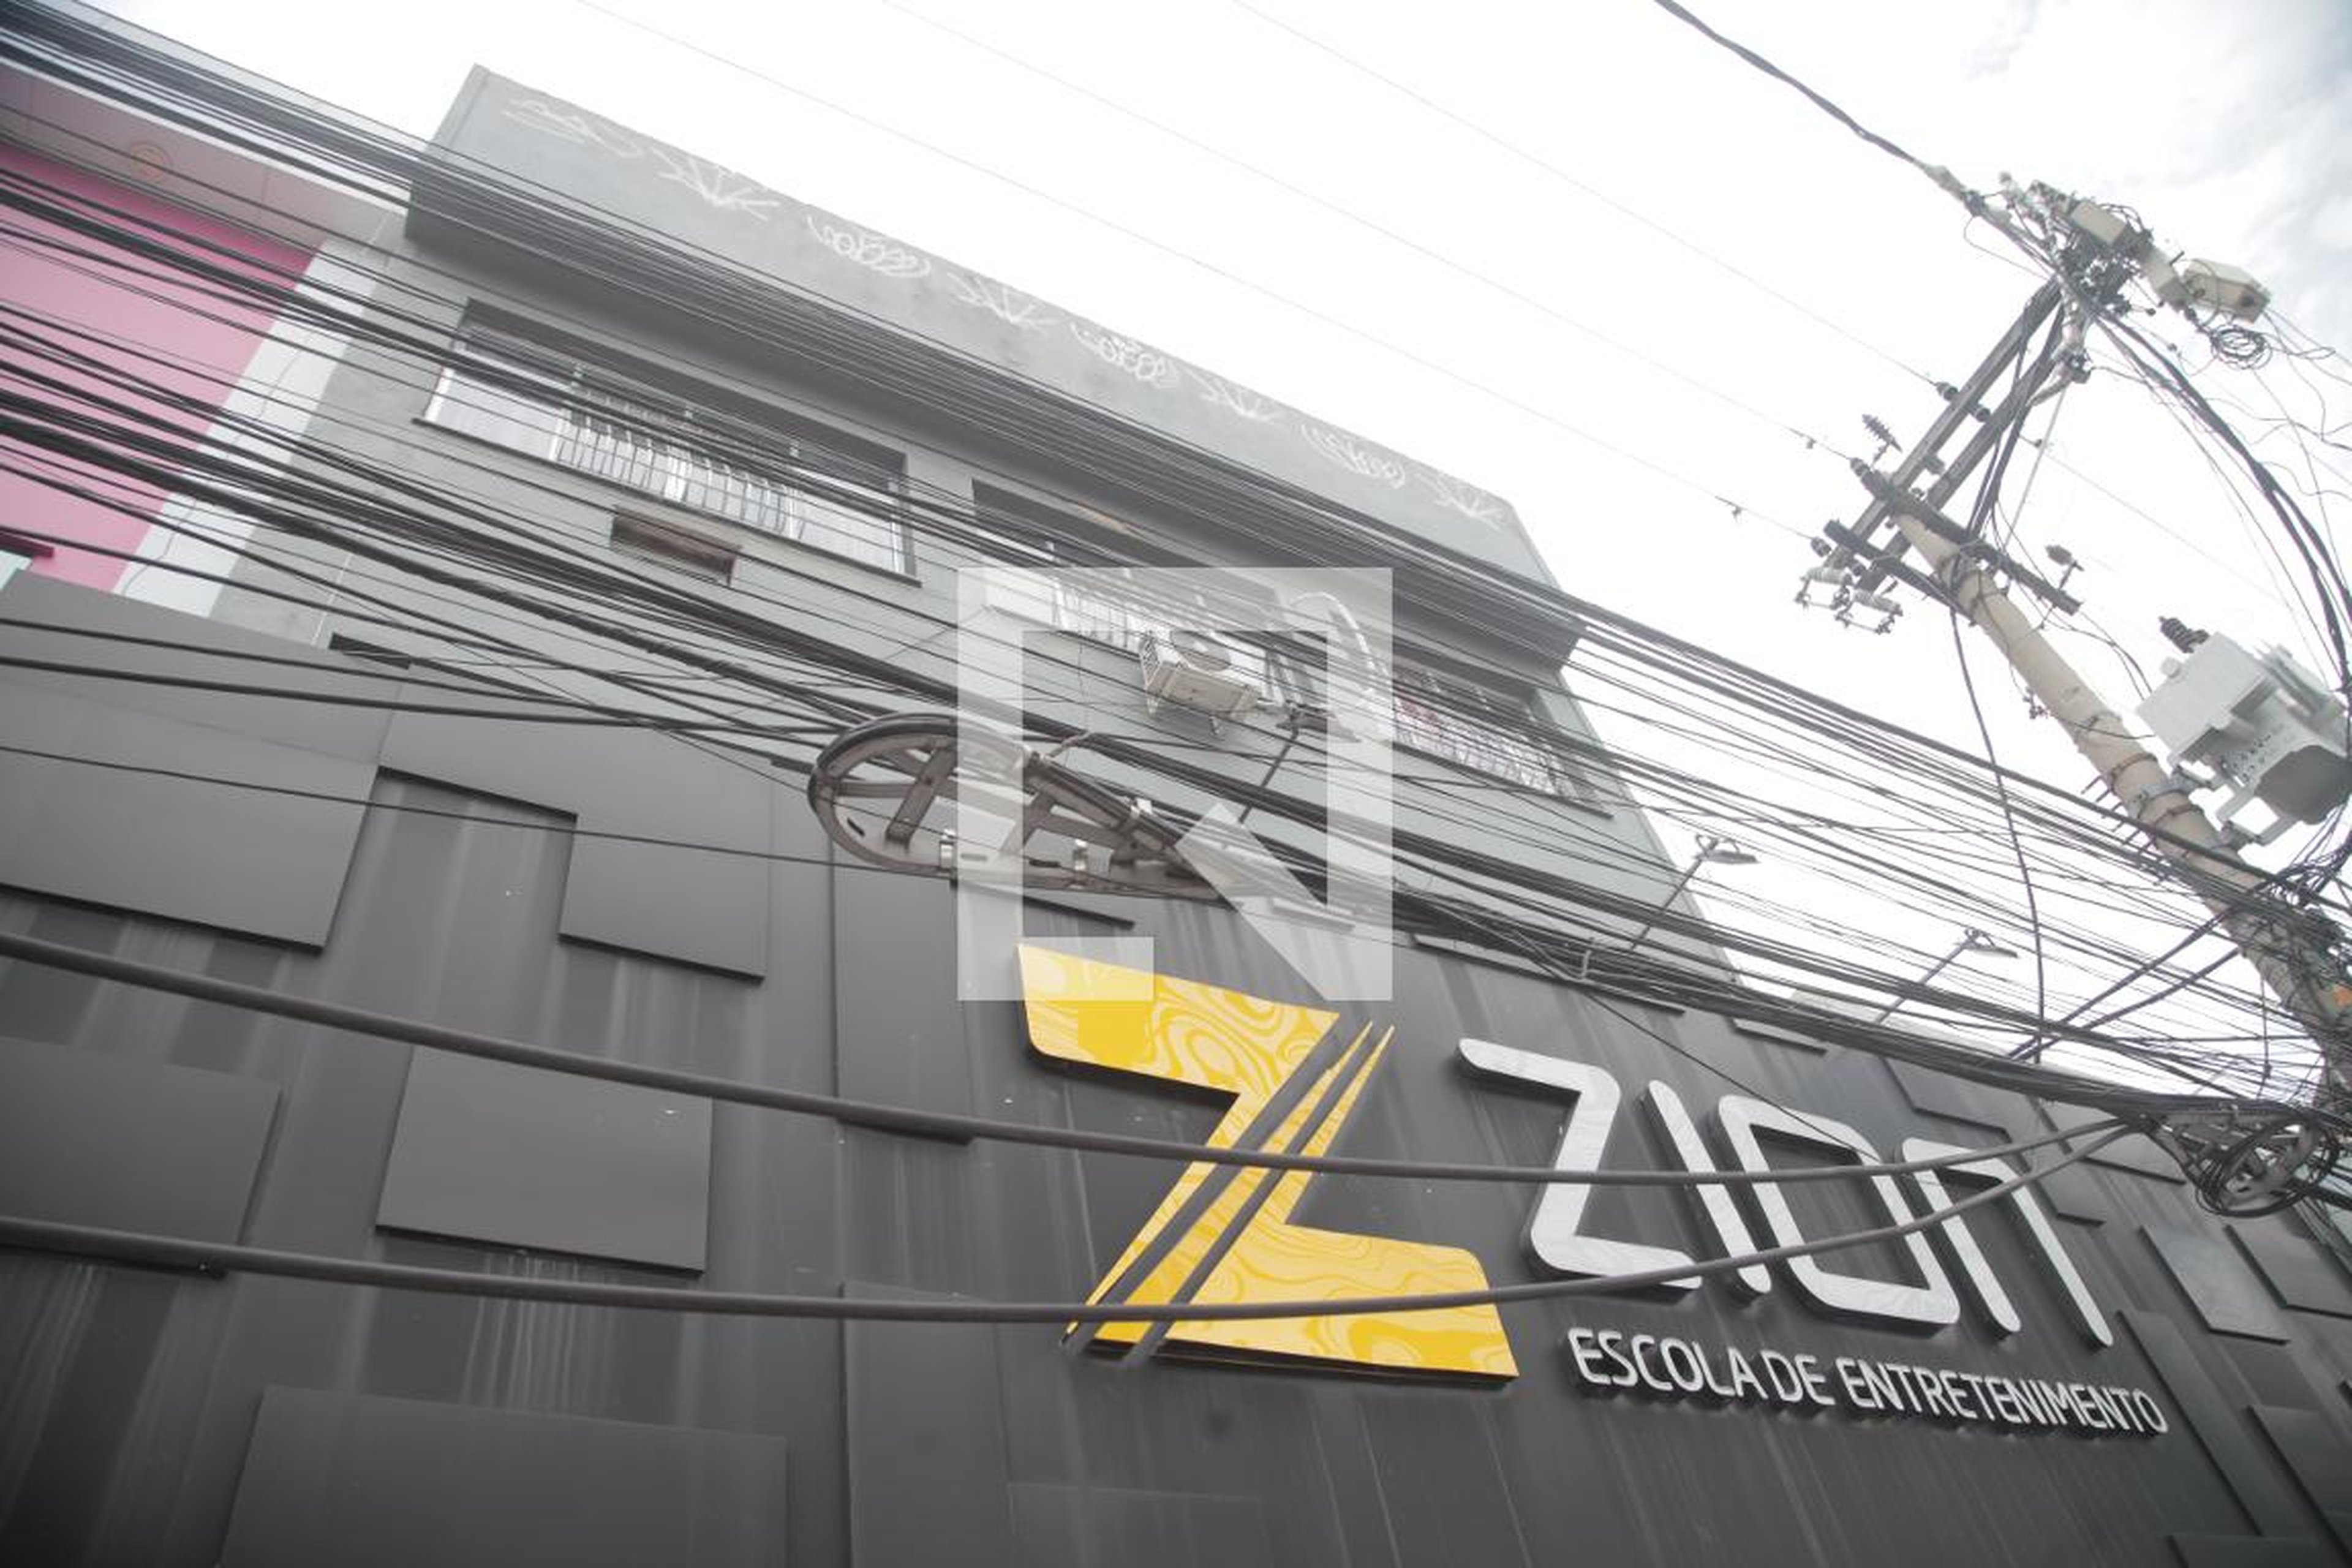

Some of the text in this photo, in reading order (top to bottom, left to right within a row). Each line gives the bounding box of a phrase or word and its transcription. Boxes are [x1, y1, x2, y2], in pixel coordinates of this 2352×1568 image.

[1458, 1038, 2113, 1346] ZION
[1568, 1327, 2168, 1433] ESCOLA DE ENTRETENIMENTO
